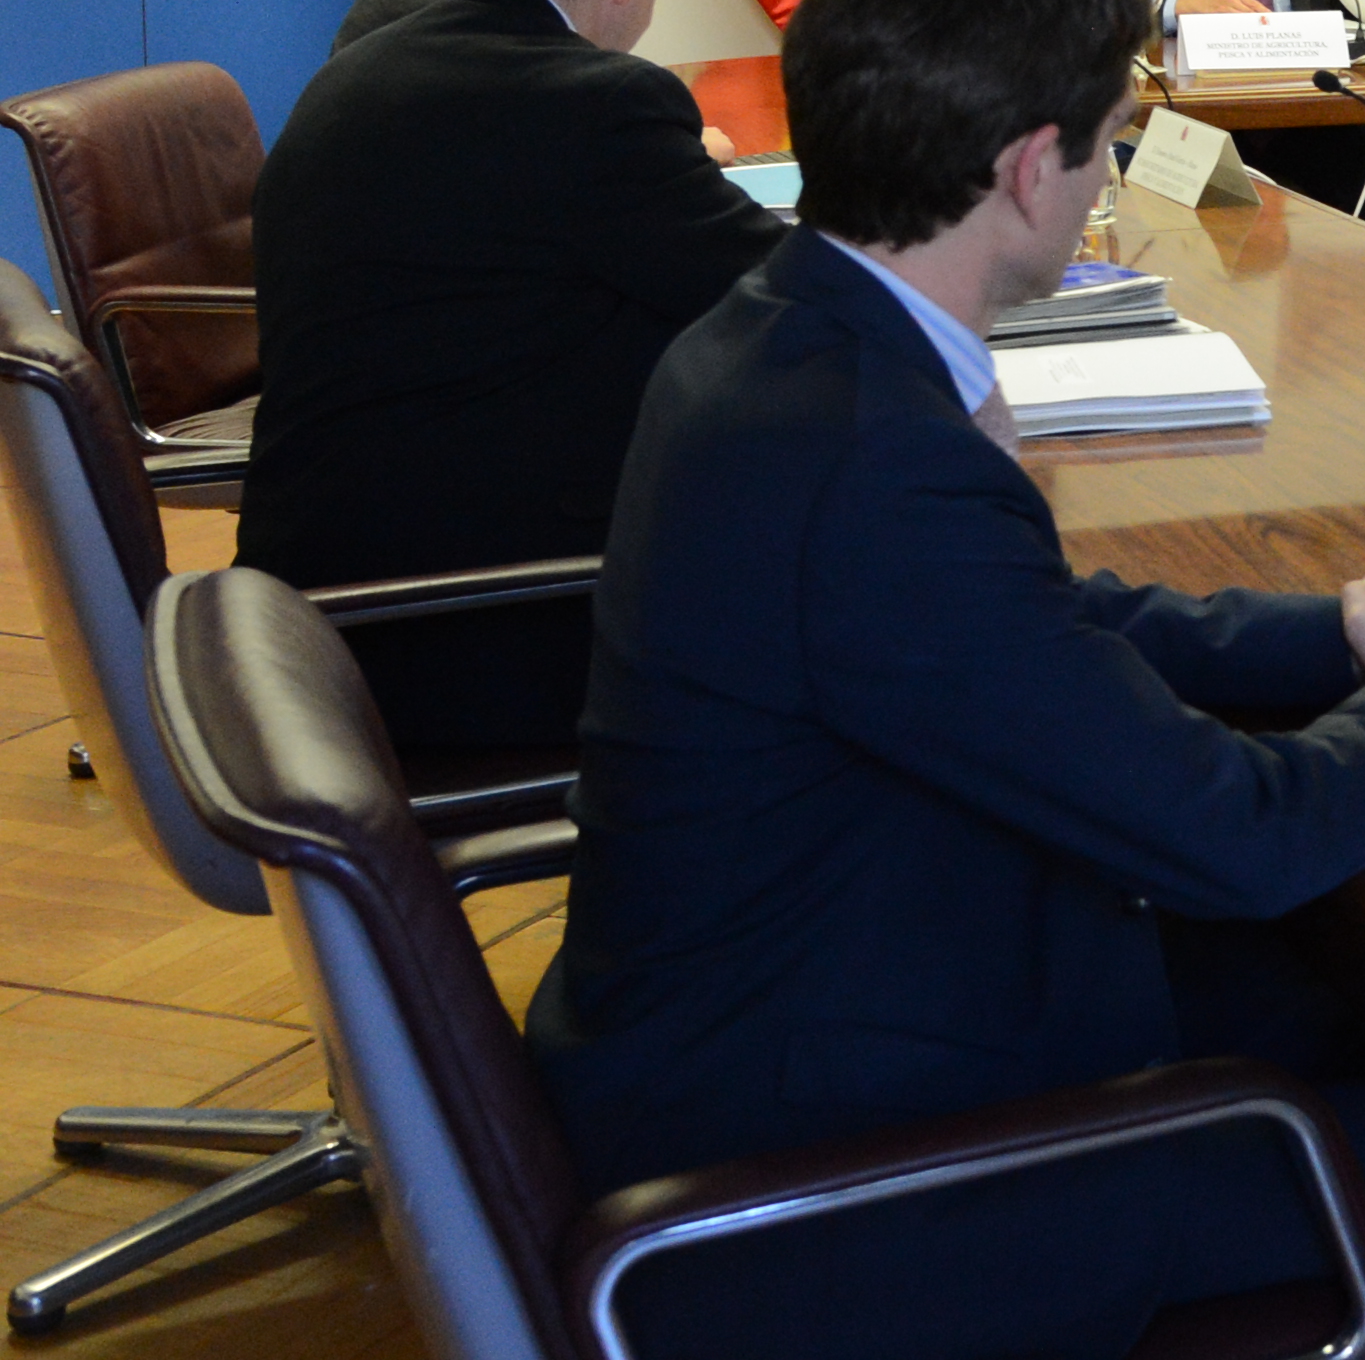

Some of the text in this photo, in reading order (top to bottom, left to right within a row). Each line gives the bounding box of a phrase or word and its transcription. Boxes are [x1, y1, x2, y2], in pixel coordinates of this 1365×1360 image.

[1242, 32, 1264, 40] LUIS
[1266, 31, 1302, 40] PLANAS
[1218, 51, 1246, 59] PESCA
